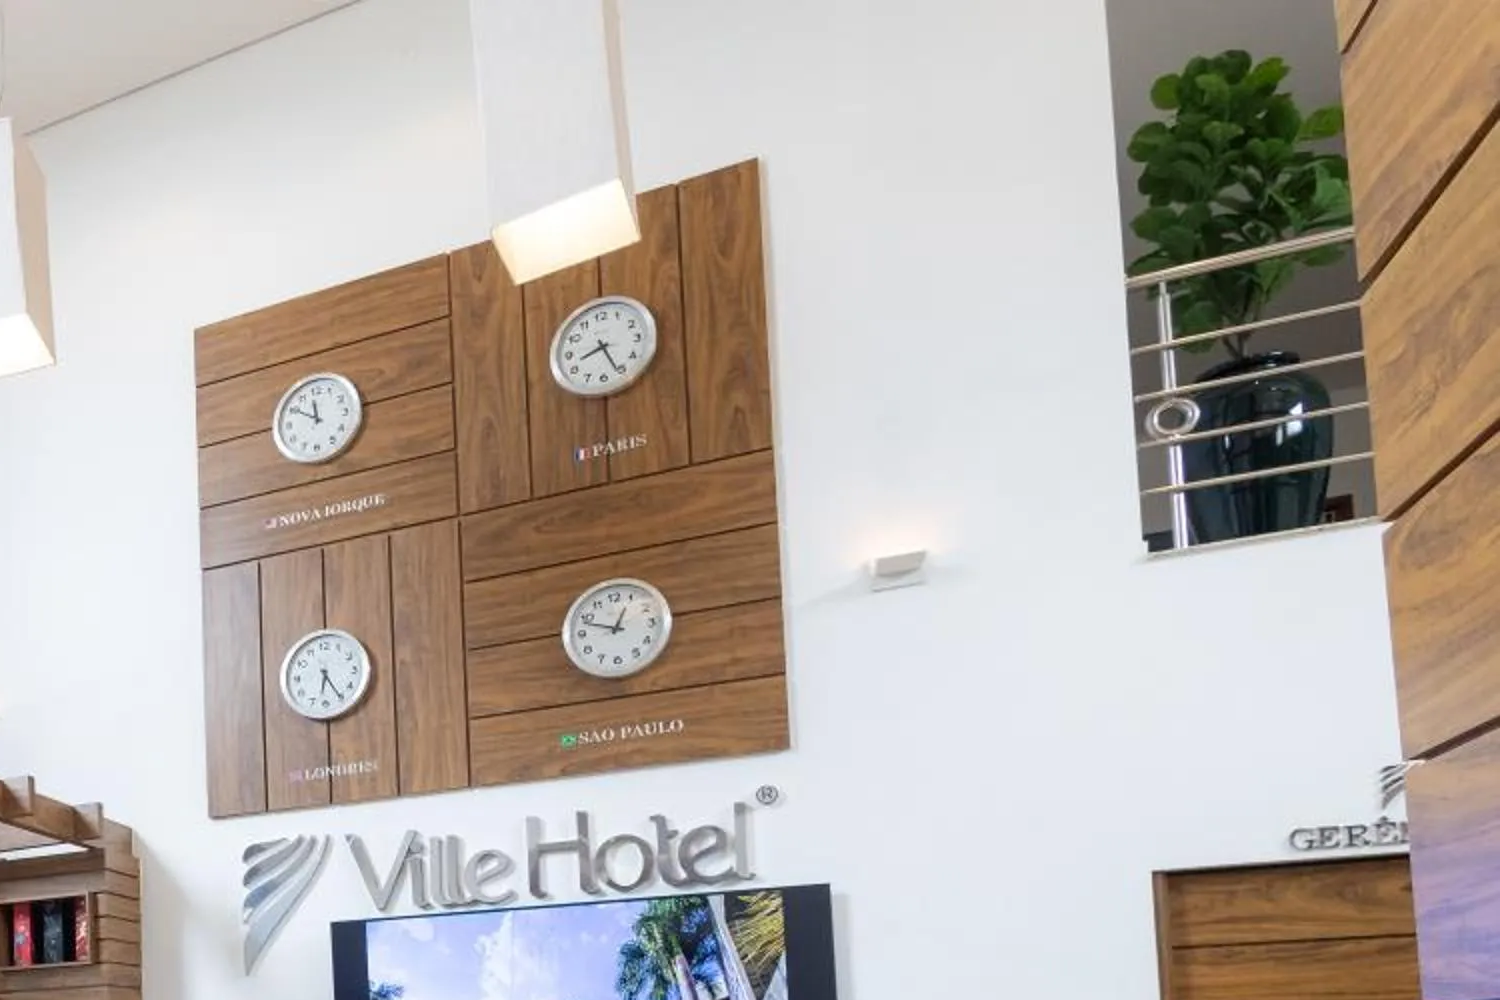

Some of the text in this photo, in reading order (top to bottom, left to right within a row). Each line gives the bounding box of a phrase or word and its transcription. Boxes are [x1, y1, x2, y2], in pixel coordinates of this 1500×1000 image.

[592, 433, 648, 457] PARIS
[279, 494, 386, 528] NOVA IORQUE
[621, 719, 684, 740] PAULO
[1288, 815, 1409, 851] GERÊ
[345, 829, 520, 913] Ville
[525, 801, 757, 900] Hotel
